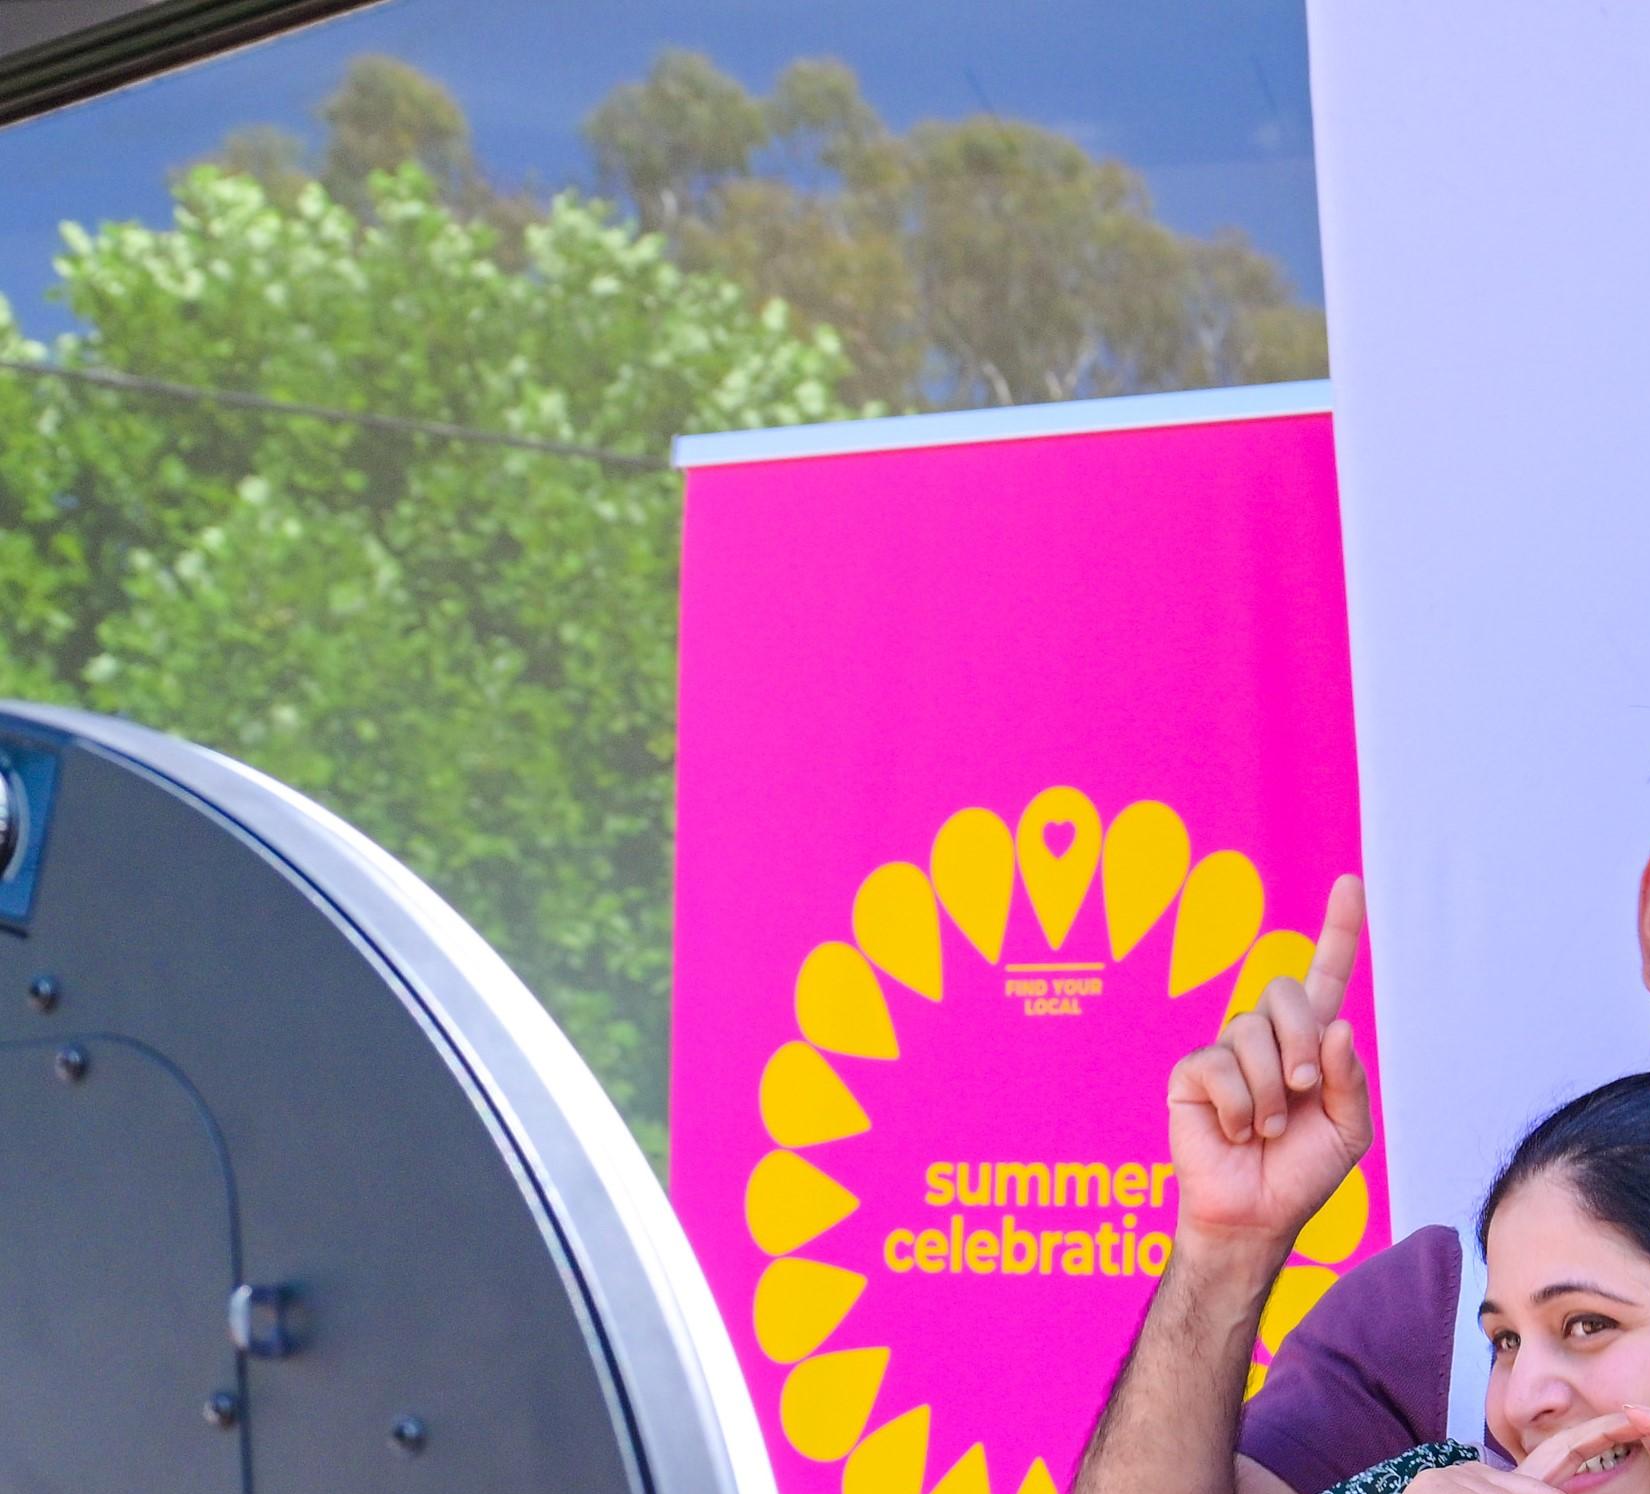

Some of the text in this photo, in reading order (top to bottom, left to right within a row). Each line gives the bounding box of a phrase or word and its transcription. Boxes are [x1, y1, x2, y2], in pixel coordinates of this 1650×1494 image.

[1006, 978, 1103, 997] FIND YOUR
[1024, 997, 1082, 1015] LOCAL
[925, 1162, 1174, 1207] summer
